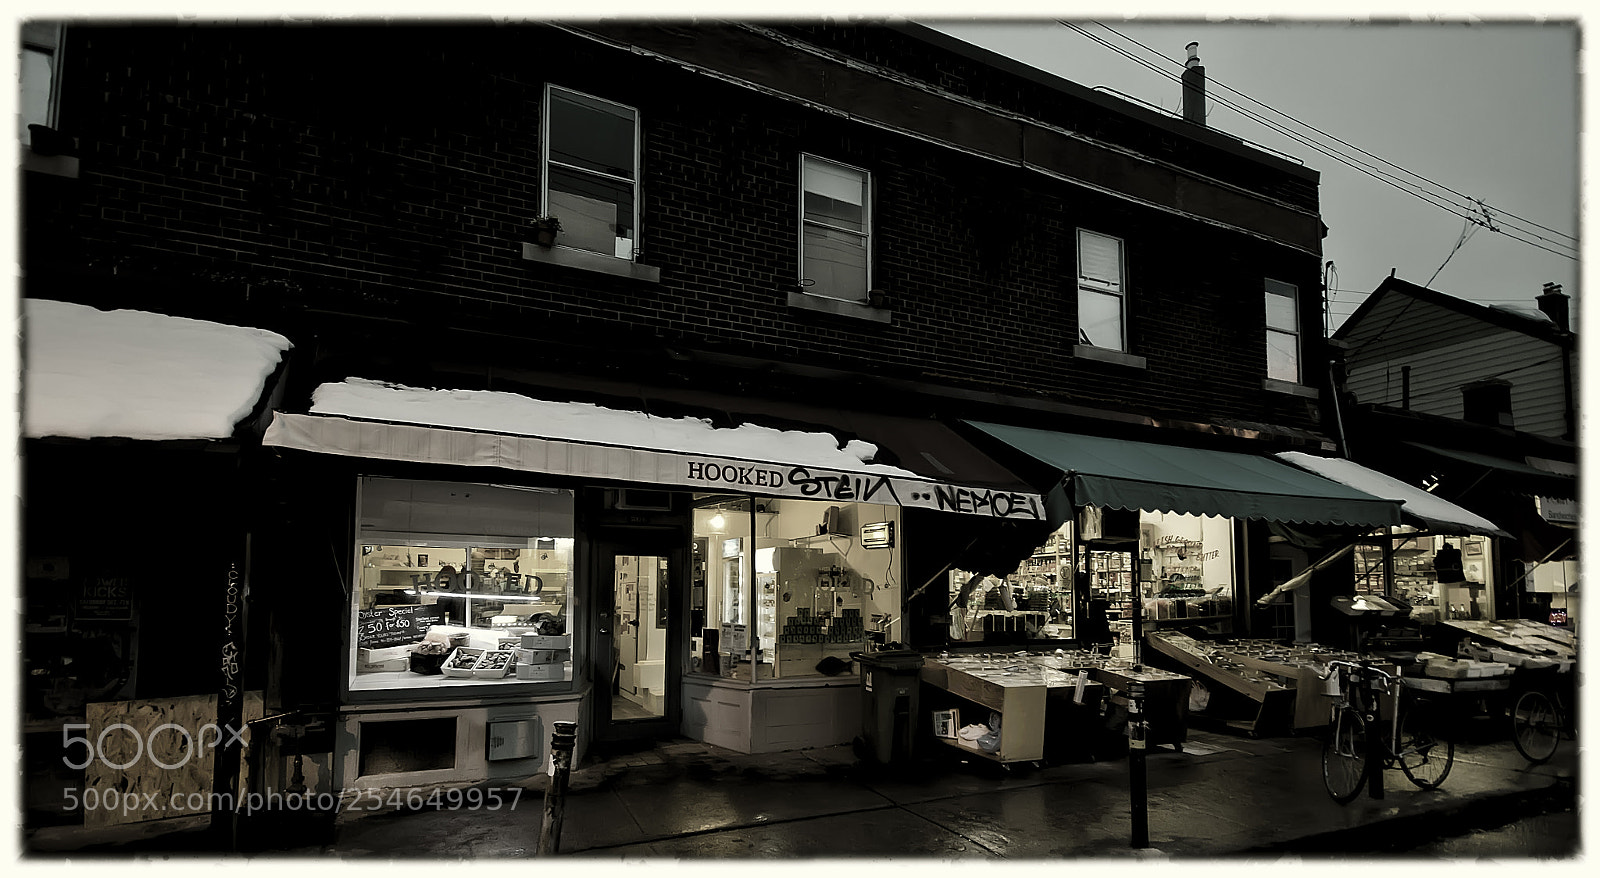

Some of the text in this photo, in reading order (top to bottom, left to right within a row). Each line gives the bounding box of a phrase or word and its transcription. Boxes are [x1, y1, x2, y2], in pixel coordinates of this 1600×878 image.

[687, 461, 784, 488] HOOKED
[410, 571, 543, 595] HOOED
[388, 606, 414, 617] Special
